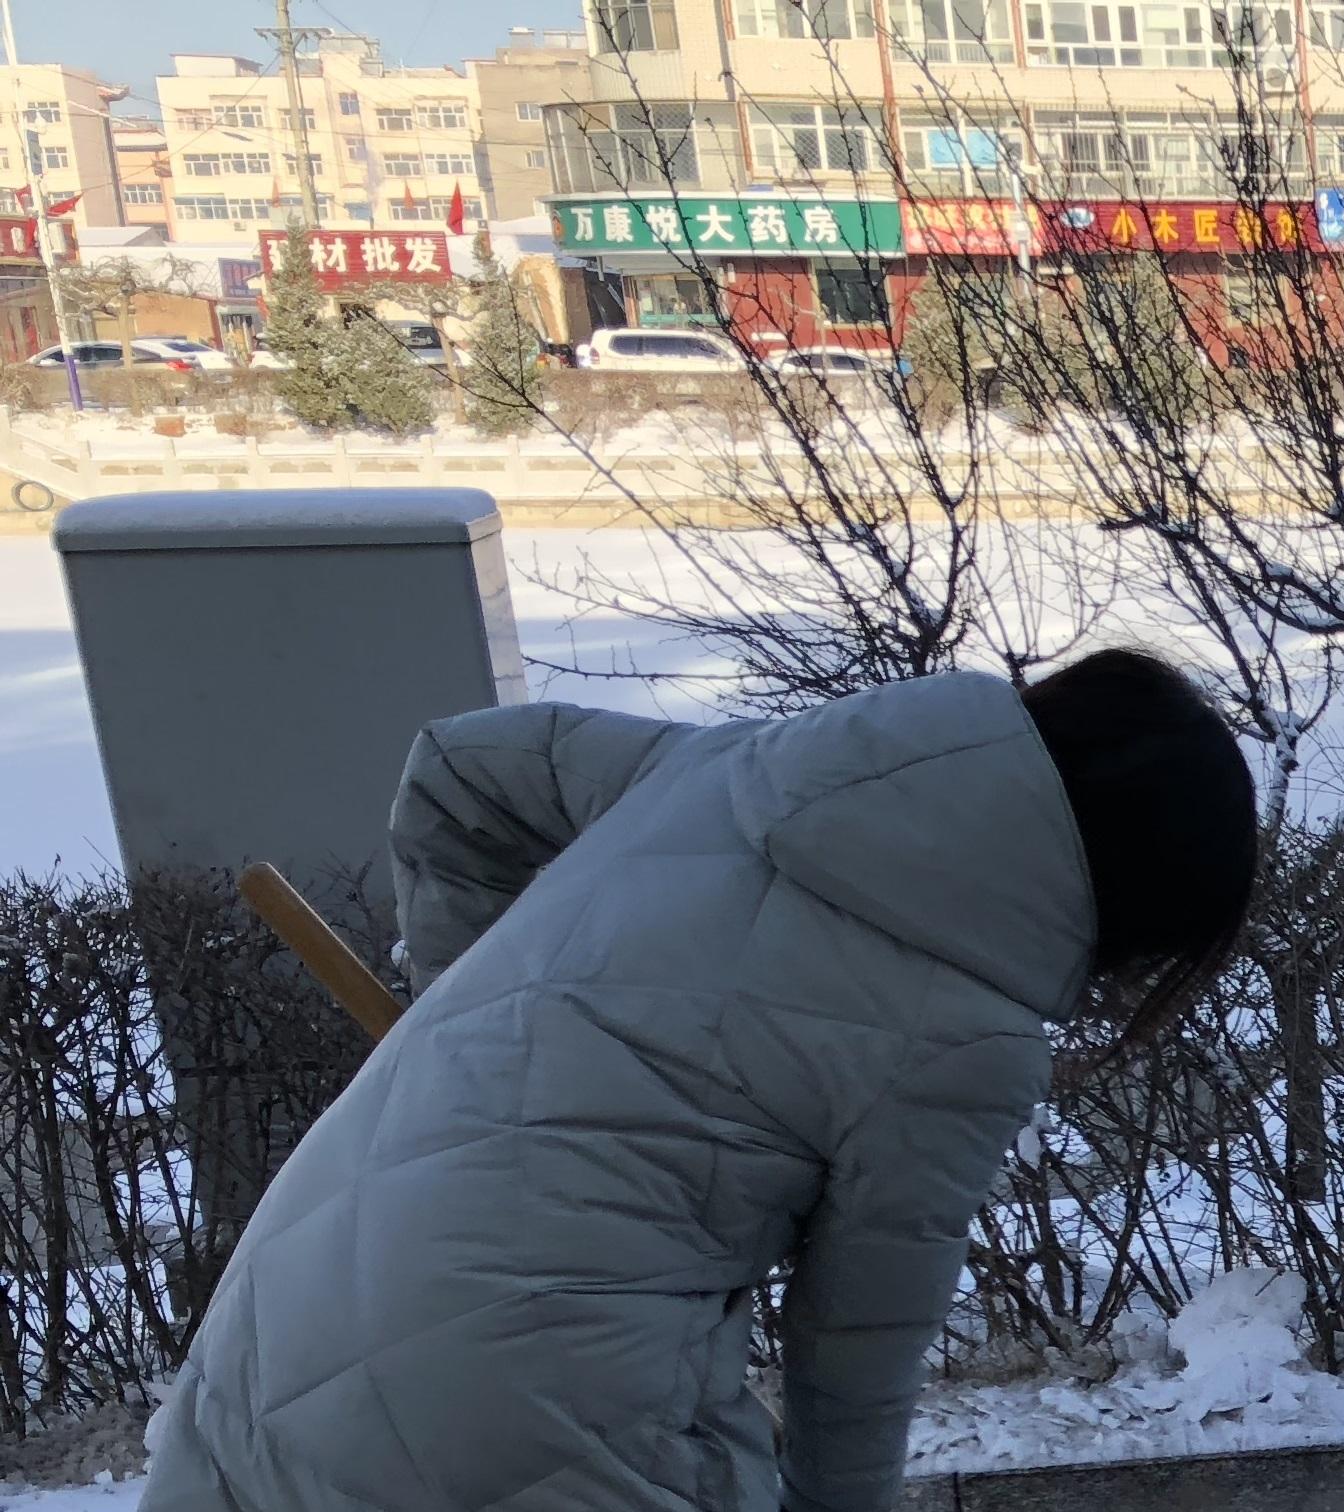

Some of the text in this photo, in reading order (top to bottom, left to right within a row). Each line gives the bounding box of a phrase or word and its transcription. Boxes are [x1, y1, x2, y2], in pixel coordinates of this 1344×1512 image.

[570, 206, 840, 243] 万康悦大药房
